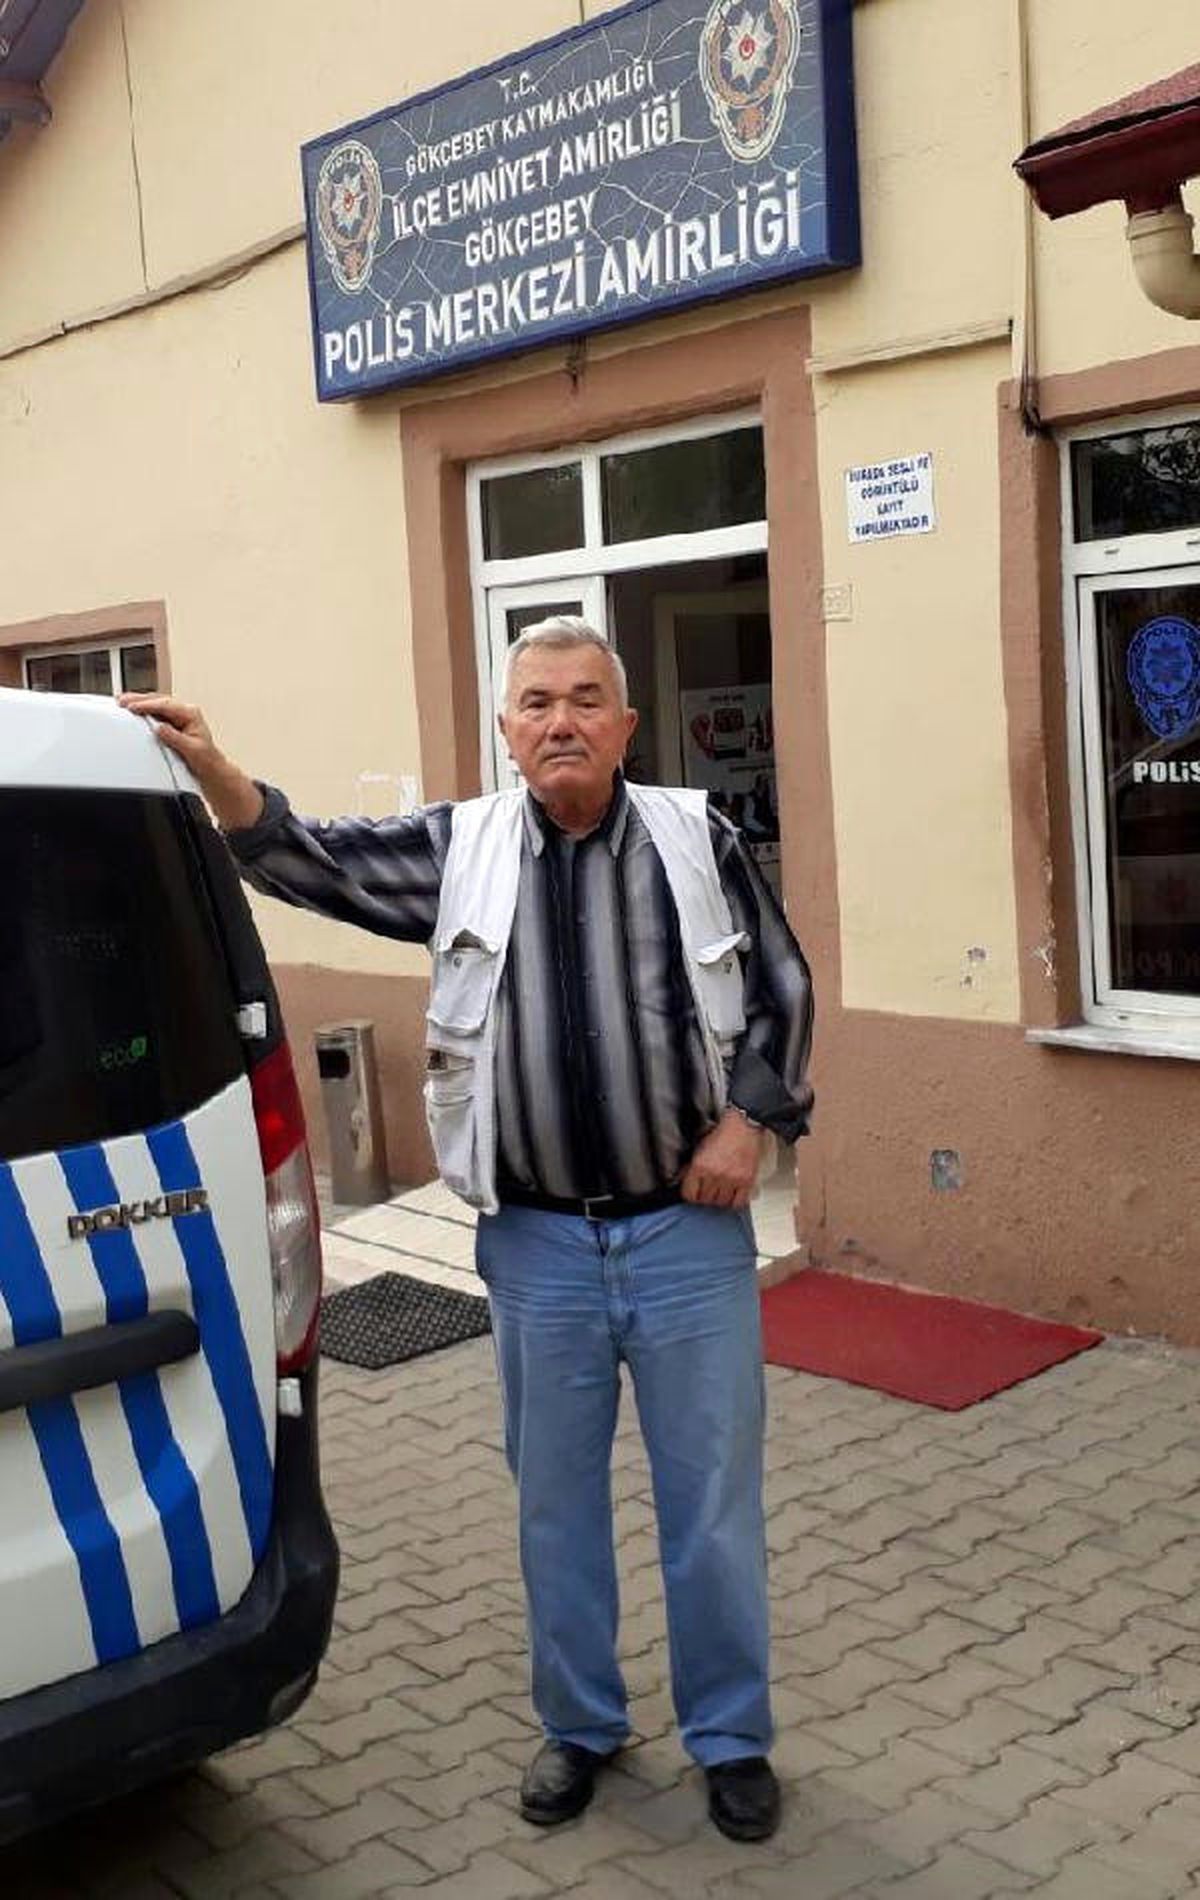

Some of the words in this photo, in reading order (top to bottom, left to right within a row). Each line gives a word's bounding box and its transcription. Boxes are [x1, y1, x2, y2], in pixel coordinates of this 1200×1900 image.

[405, 124, 500, 178] GÖKÇEBEY
[501, 59, 654, 144] KAYMAKAMLIĞI
[500, 70, 536, 102] T.C.
[393, 189, 441, 240] İLÇE
[447, 149, 552, 212] EMNİYET
[559, 90, 683, 177] AMİRLİĞİ
[323, 303, 415, 379] POLİS
[424, 246, 587, 349] MERKEZİ
[598, 171, 800, 296] AMİRLİĞİ
[464, 193, 597, 268] GÖKÇEBEY
[67, 1190, 209, 1239] DOKKER
